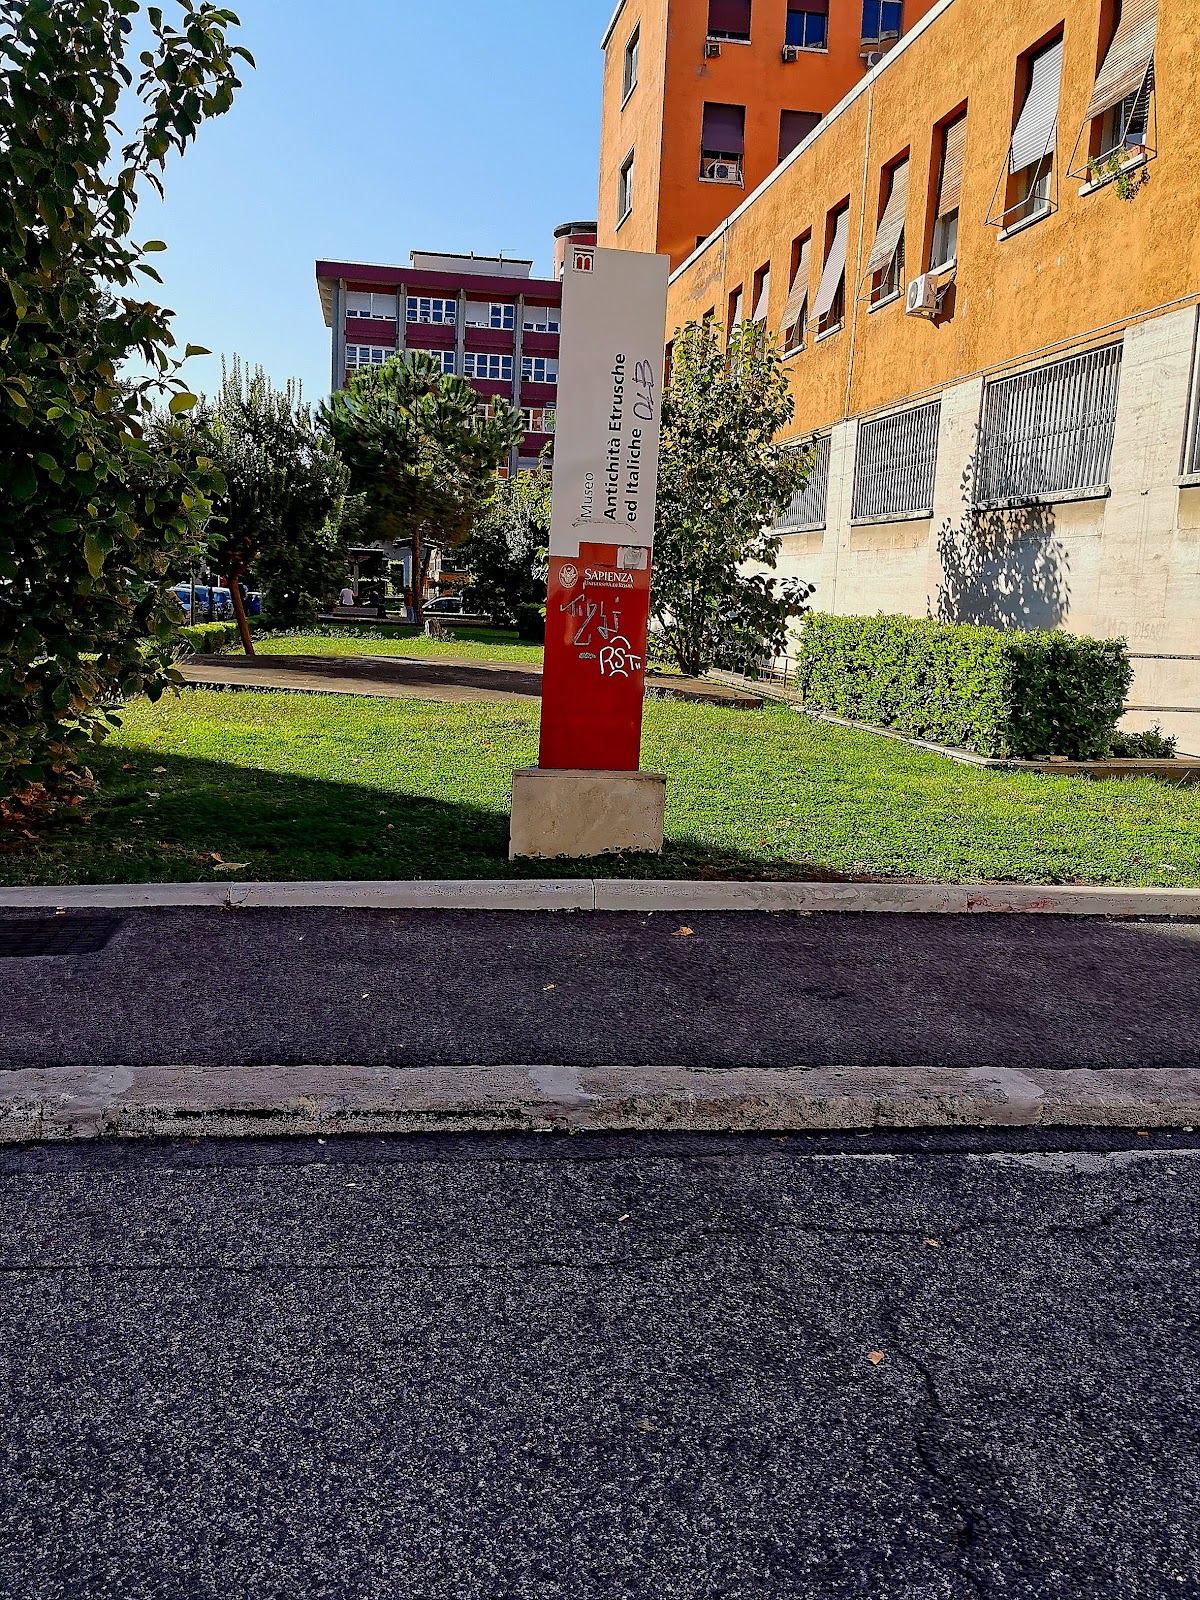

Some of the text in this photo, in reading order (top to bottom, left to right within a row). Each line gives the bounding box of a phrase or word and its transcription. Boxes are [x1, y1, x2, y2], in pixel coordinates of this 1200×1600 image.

[604, 353, 626, 520] Antichità Etrusche
[624, 428, 642, 522] ed Italiche
[580, 472, 594, 518] Museo
